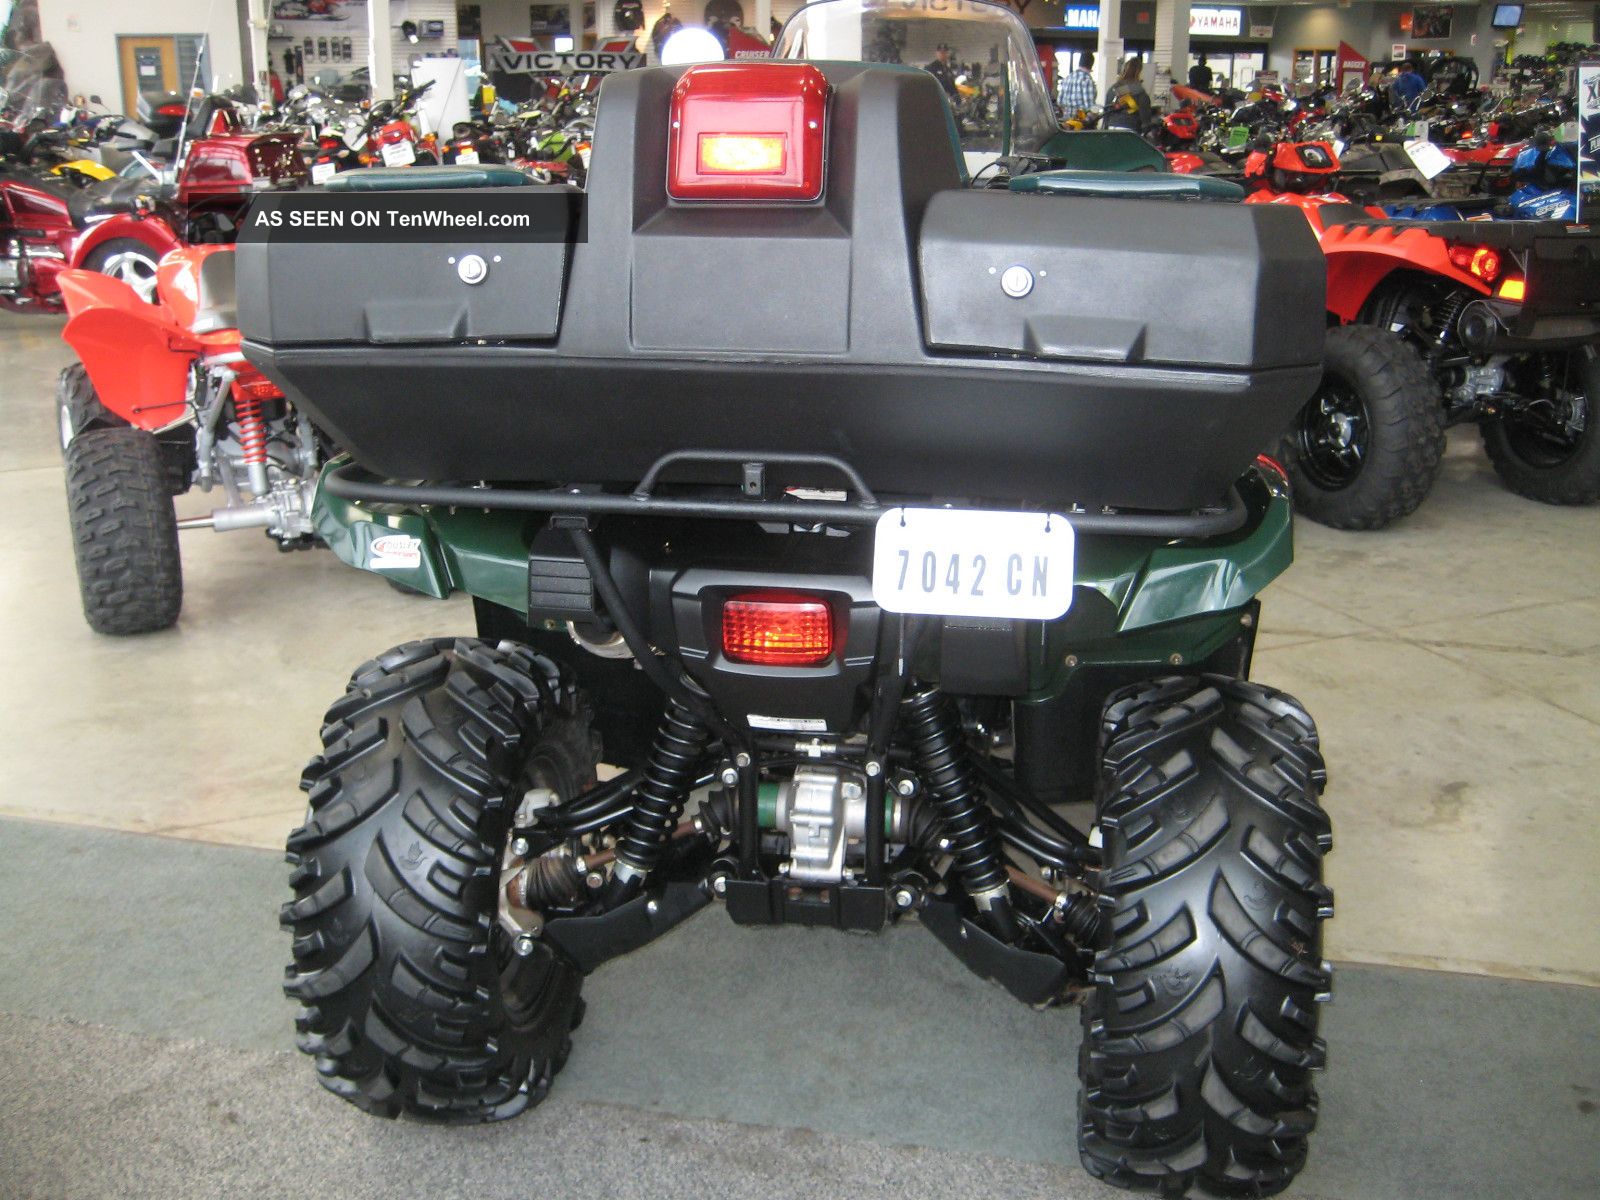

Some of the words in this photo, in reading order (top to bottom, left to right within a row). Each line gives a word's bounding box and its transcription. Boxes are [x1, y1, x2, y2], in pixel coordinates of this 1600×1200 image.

[1197, 17, 1238, 28] YAMAHA
[504, 53, 637, 70] VICTORY
[897, 549, 987, 597] 7042
[1006, 553, 1049, 598] CN
